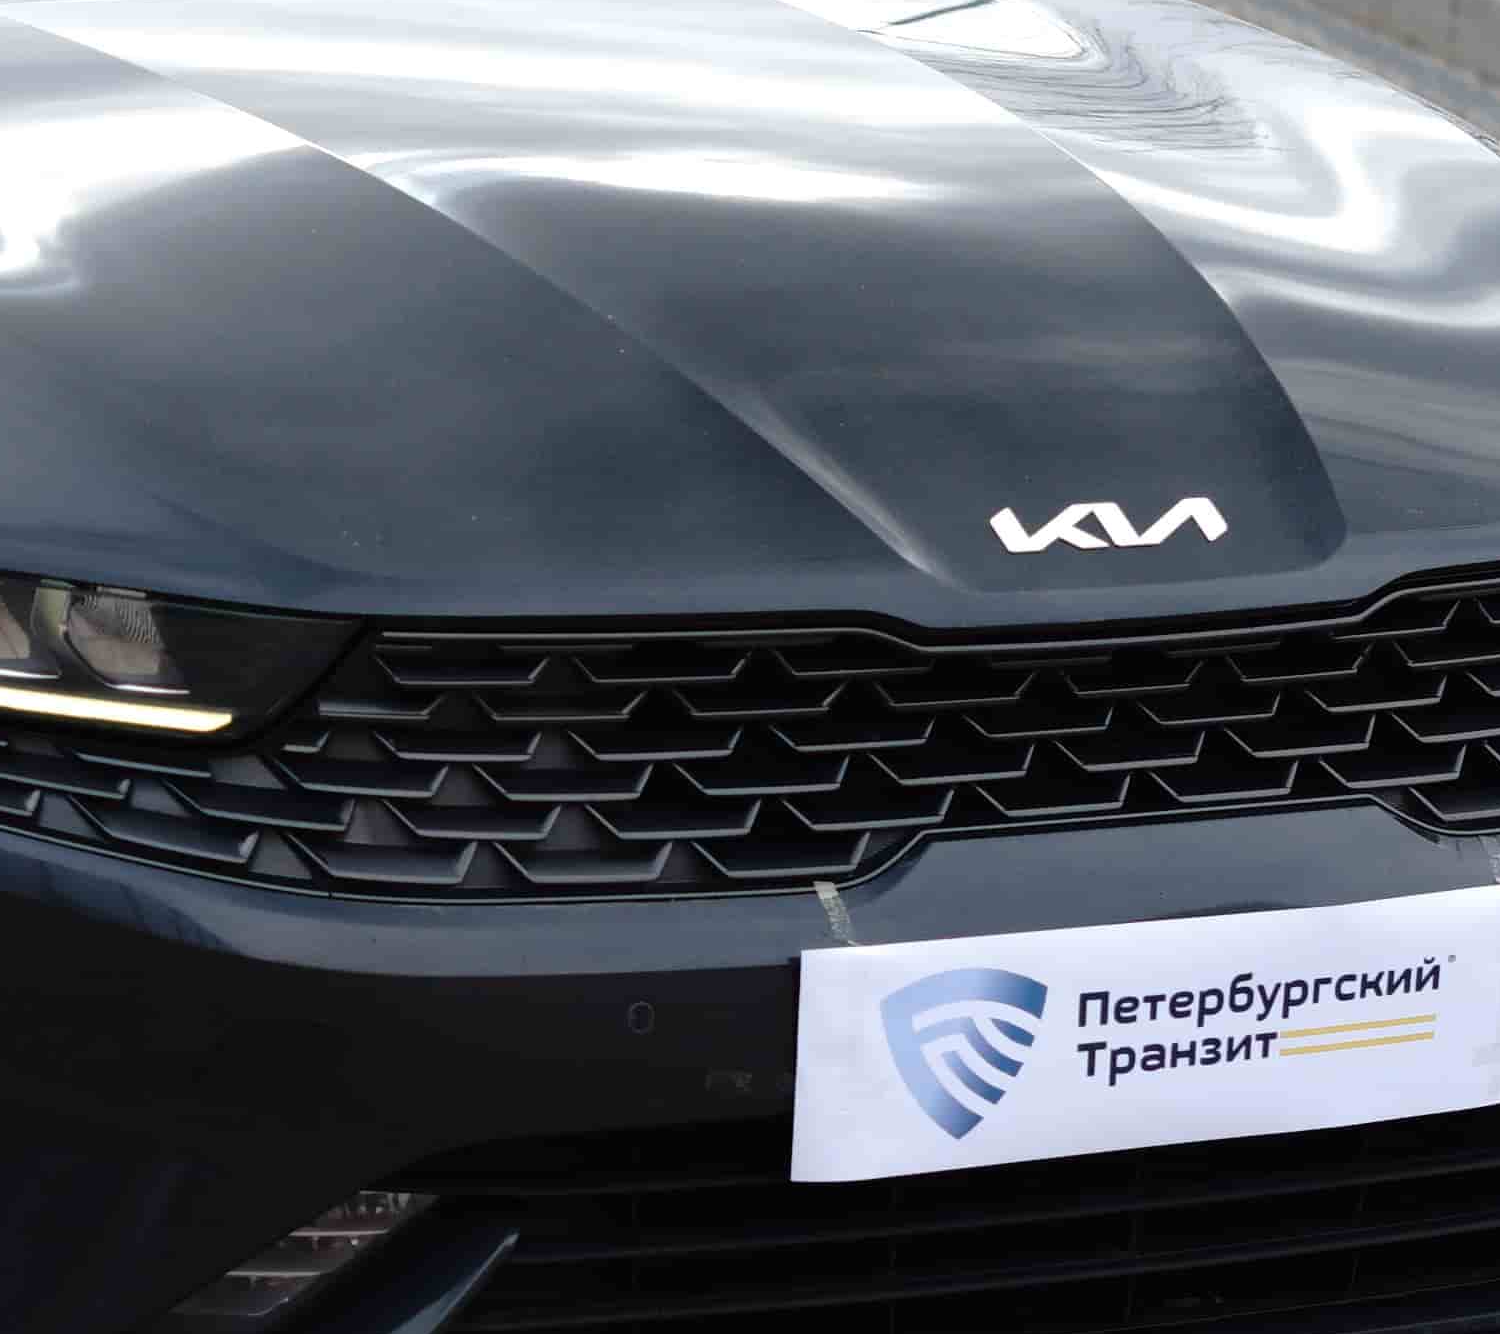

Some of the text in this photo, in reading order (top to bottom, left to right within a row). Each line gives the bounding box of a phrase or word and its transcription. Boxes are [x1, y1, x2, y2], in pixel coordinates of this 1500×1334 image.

[989, 497, 1228, 553] KIA
[1077, 955, 1442, 1028] Петербургский
[1076, 1030, 1279, 1087] Транзит
